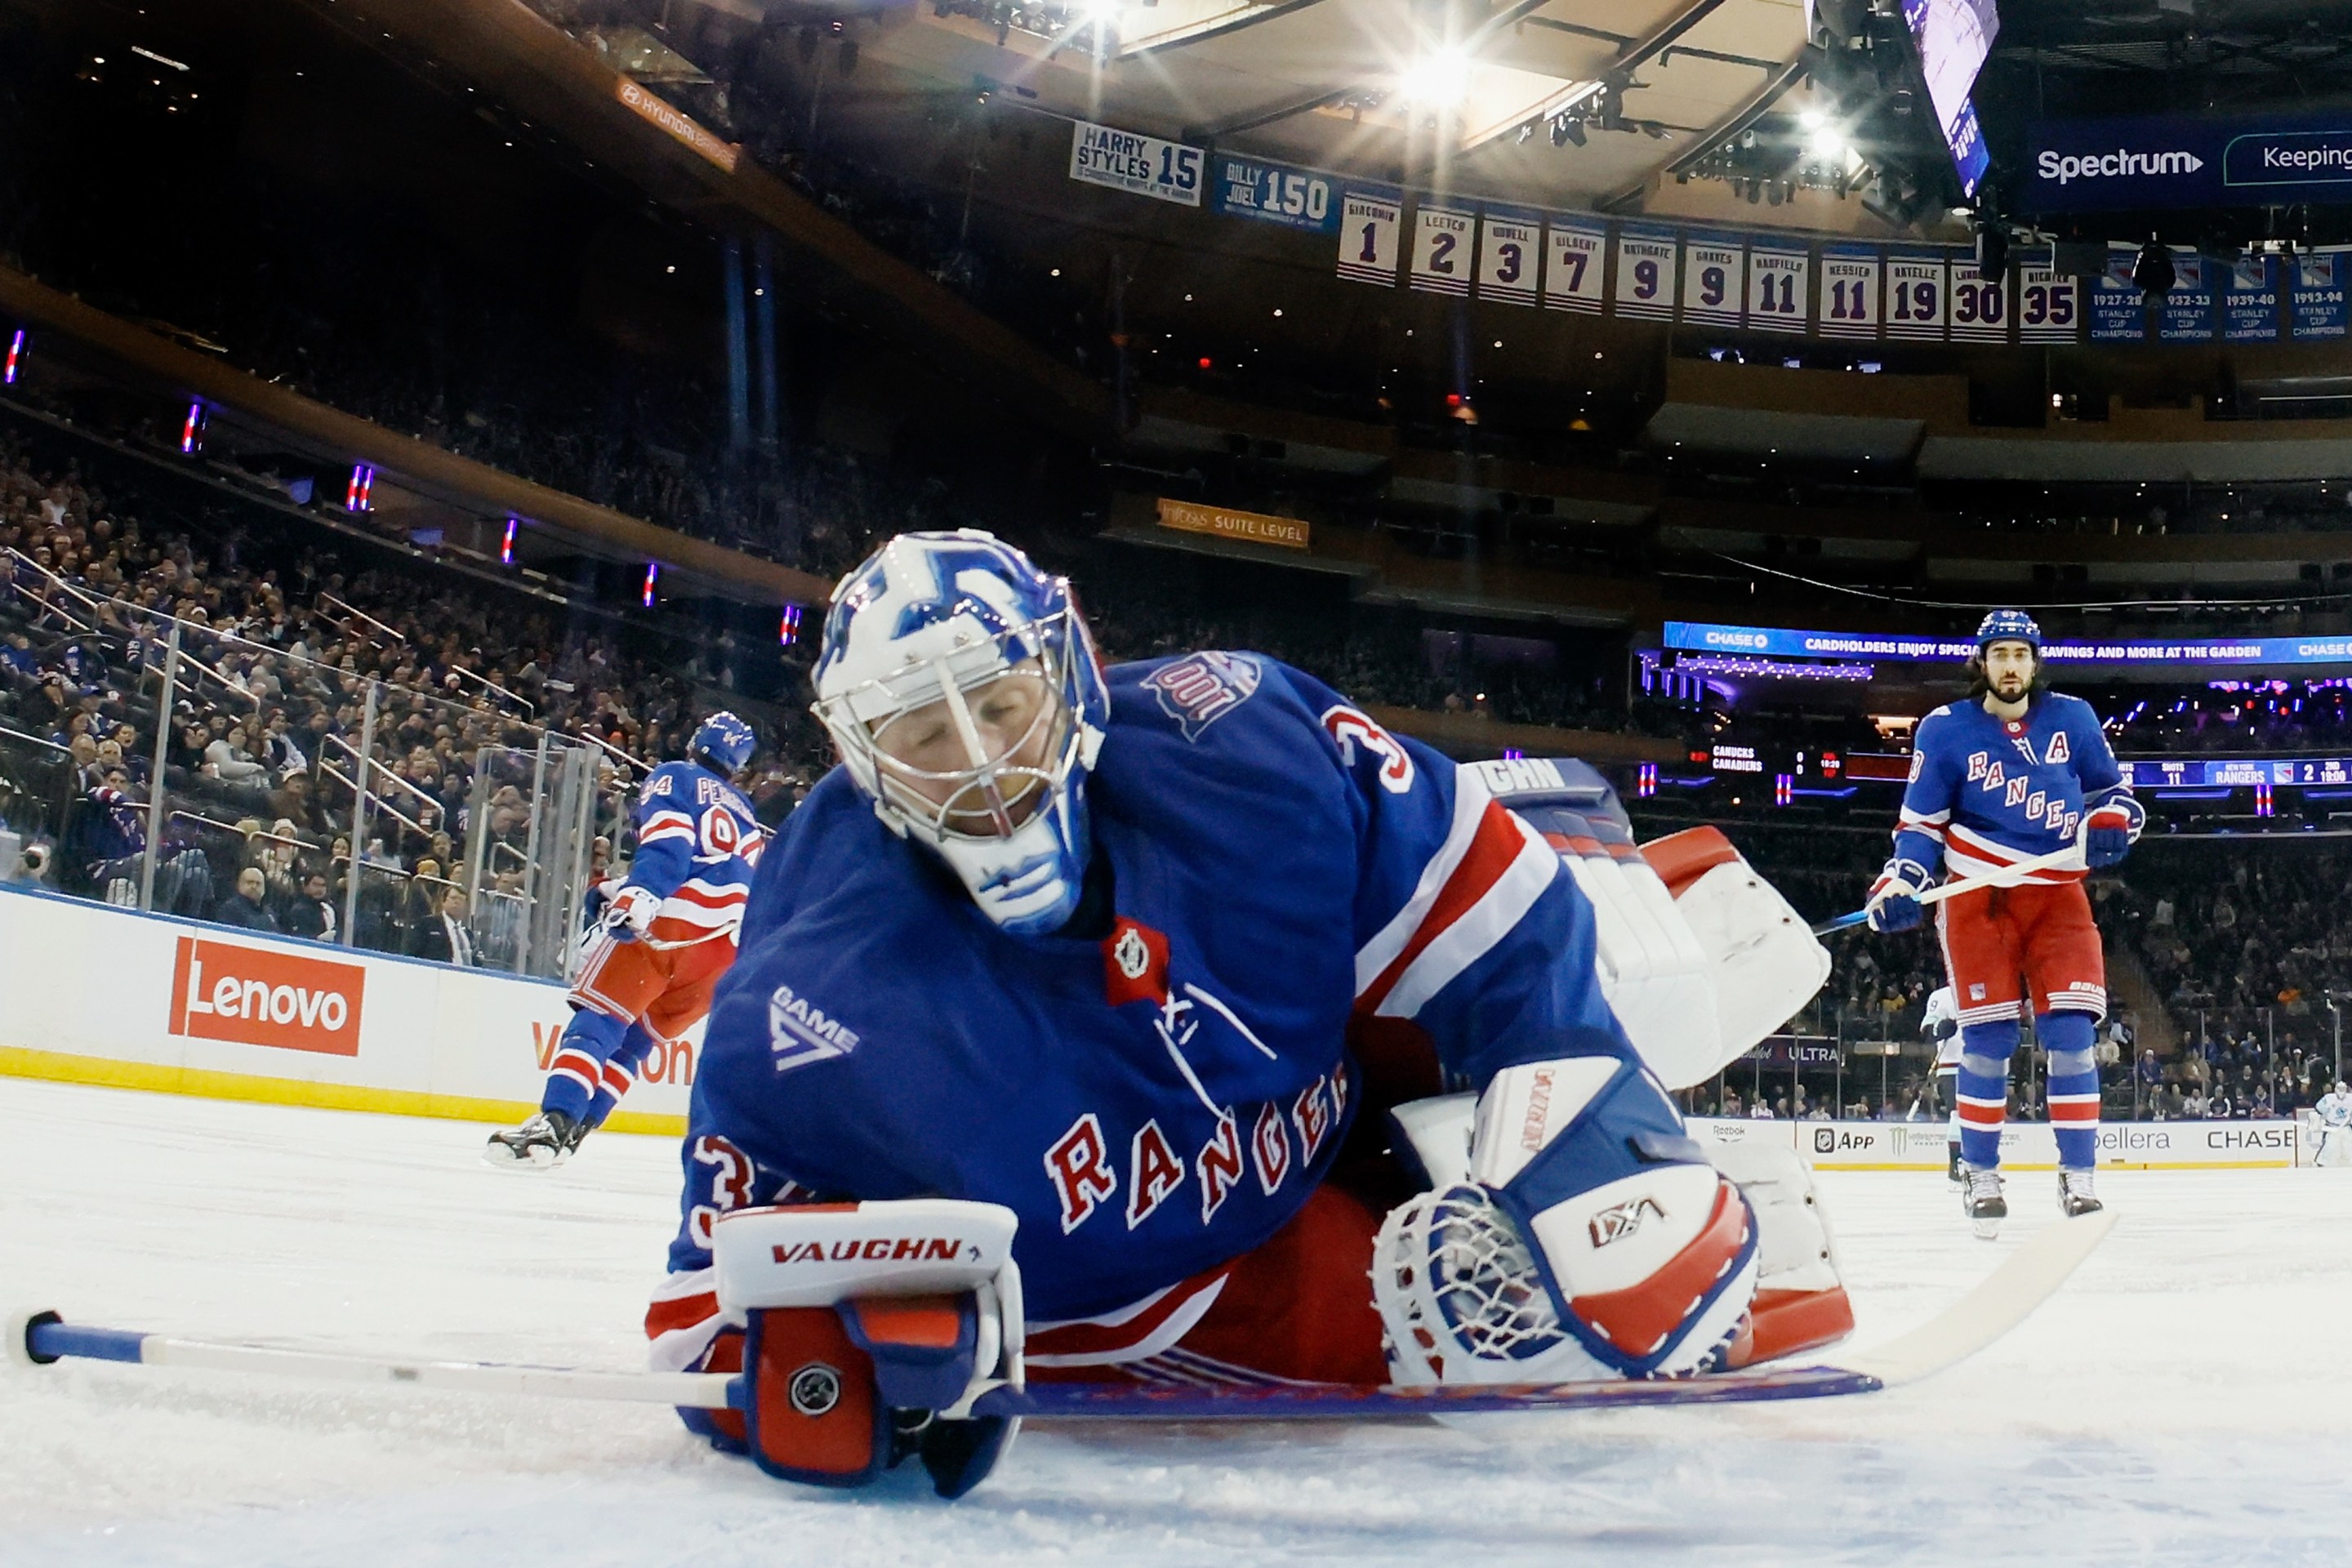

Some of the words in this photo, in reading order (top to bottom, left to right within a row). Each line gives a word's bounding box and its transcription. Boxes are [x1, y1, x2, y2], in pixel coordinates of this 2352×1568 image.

[642, 97, 697, 143] HYUNDAI
[1085, 127, 1147, 158] HARRY
[1078, 145, 1151, 179] STYLES
[1157, 145, 1199, 189] 15
[2038, 149, 2193, 185] Spectrum
[2264, 145, 2352, 171] Keeping
[1227, 163, 1263, 186] BILLY
[1226, 183, 1258, 207] JOEL
[1263, 171, 1330, 220] 150
[1426, 216, 1466, 233] LEETCH
[1360, 222, 1378, 263] 1
[1430, 232, 1456, 274] 2
[1496, 243, 1522, 283] 3
[1563, 252, 1588, 292] 7
[1634, 260, 1659, 300] 9
[1700, 266, 1725, 306] 9
[1760, 273, 1795, 314] 11
[1830, 280, 1866, 319] 11
[1895, 281, 1937, 321] 19
[1956, 284, 2003, 323] 30
[2024, 286, 2074, 325] 35
[2093, 294, 2143, 306] 1927-28
[2167, 295, 2211, 306] 932-33
[2226, 294, 2275, 306] 1939-40
[2098, 310, 2136, 318] STANLEY
[2167, 310, 2206, 318] STANLEY
[2230, 309, 2270, 318] STANLEY
[2299, 306, 2338, 315] STANLEY
[2109, 319, 2127, 328] CUP
[2177, 319, 2196, 328] CUP
[2242, 319, 2261, 328] CUP
[2310, 316, 2328, 326] CUP
[2091, 330, 2143, 338] CHAMPIONS
[2161, 330, 2212, 339] CHAMPIONS
[2225, 328, 2277, 338] CHAMPIONS
[2293, 327, 2345, 336] CHAMPIONS
[1214, 515, 1255, 533] SUITE
[1261, 523, 1303, 541] LEVEL
[1706, 631, 1753, 647] CHASE
[1805, 638, 1896, 654] CARDHOLDERS
[1898, 641, 1937, 657] ENJOY
[1938, 644, 1980, 656] SPECIA
[2042, 646, 2095, 658] SAVINGS
[2096, 647, 2125, 658] AND
[2127, 646, 2164, 659] MORE
[2166, 647, 2183, 659] AT
[2183, 646, 2207, 658] THE
[2209, 645, 2261, 658] GARDEN
[2298, 644, 2346, 656] CHASE
[1713, 745, 1755, 759] CANUCKS
[2045, 731, 2072, 764] A
[1713, 758, 1763, 773] CANADIENS
[2162, 763, 2185, 773] SHOTS
[2303, 764, 2314, 782] 2
[2168, 772, 2181, 786] 11
[2216, 770, 2265, 784] RANGERS
[188, 960, 348, 1031] Lenovo
[772, 985, 861, 1054] GAME
[1788, 1046, 1839, 1062] ULTRA
[1713, 1125, 1745, 1136] Reebok
[2207, 1129, 2294, 1149] CHASE
[771, 1238, 963, 1264] VAUGHN
